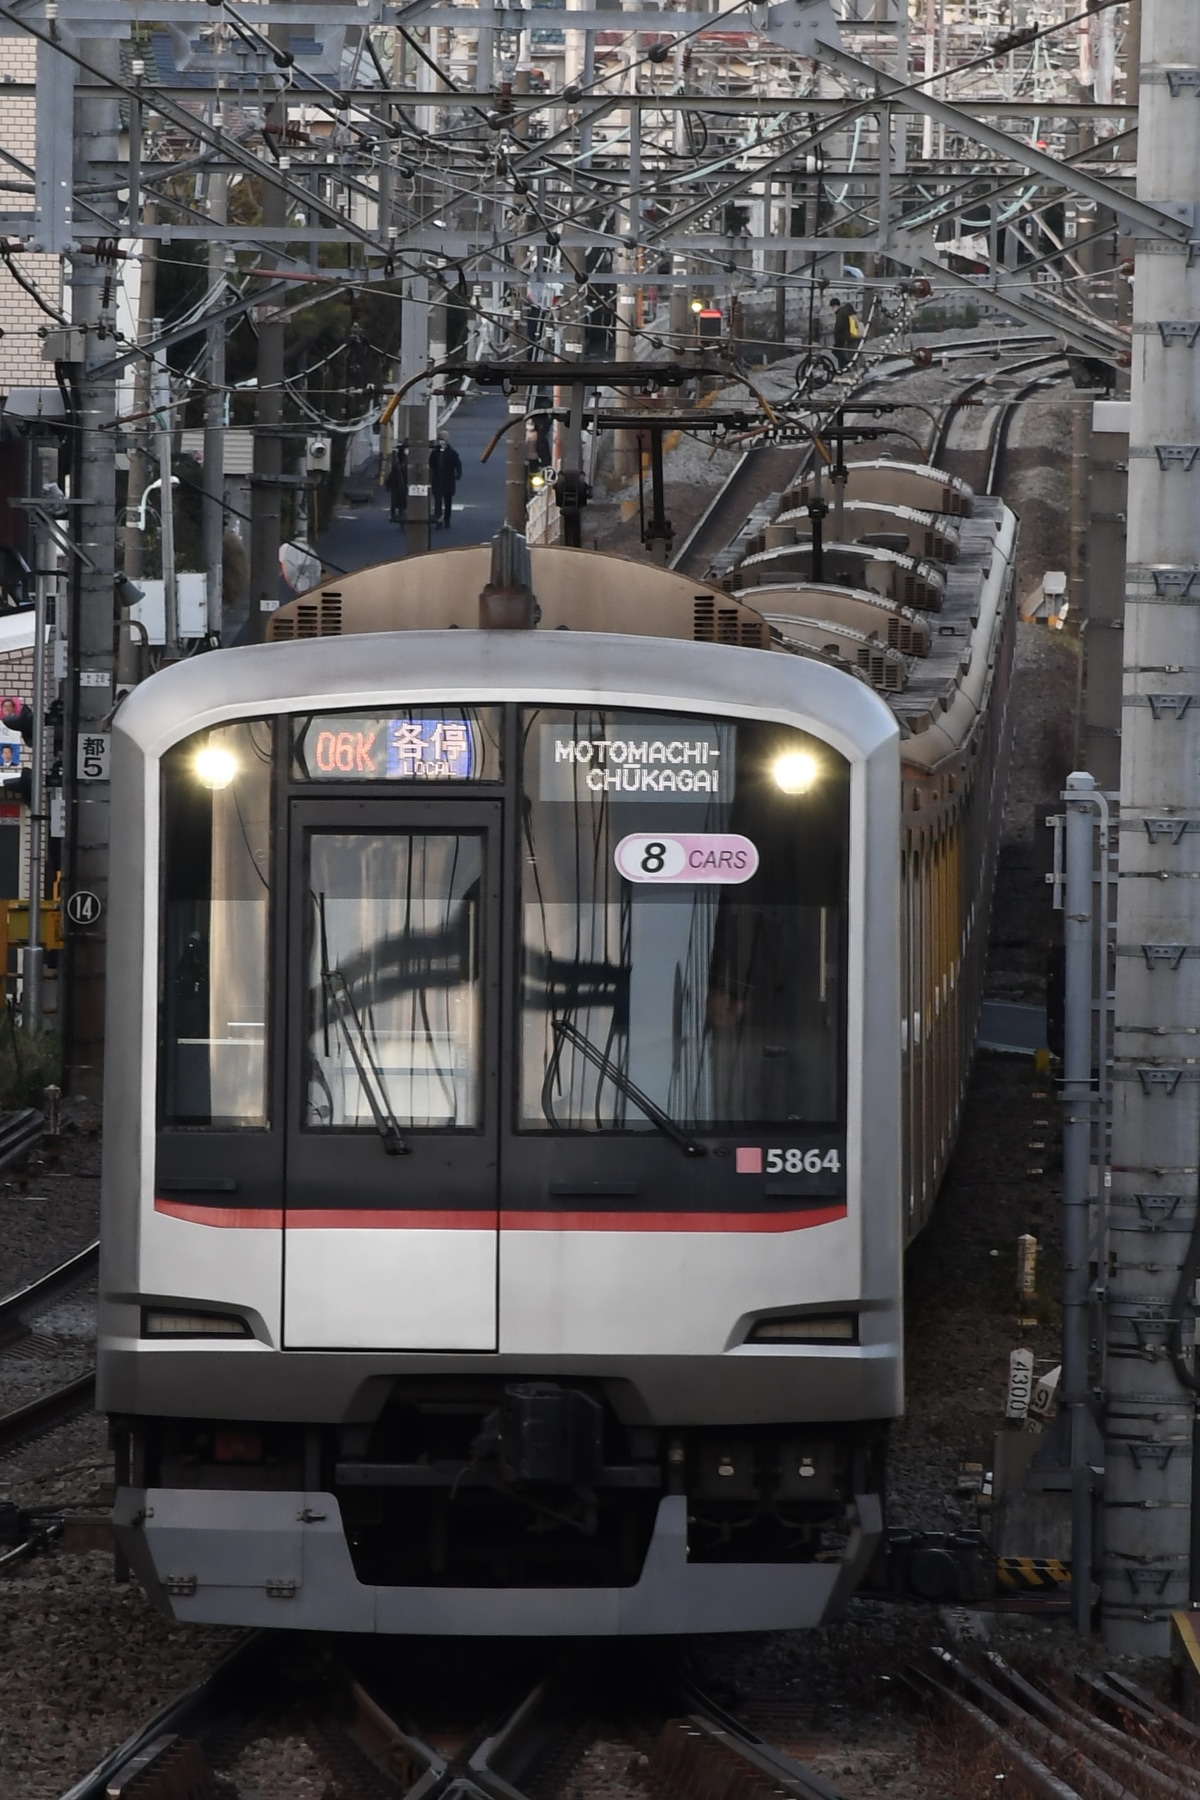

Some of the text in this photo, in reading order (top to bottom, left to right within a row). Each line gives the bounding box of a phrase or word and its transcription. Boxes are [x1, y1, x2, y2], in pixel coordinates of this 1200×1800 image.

[316, 731, 376, 772] 06K
[392, 722, 468, 761] 各停
[554, 740, 721, 764] MOTOMACHI-
[403, 761, 457, 776] LOCAL
[640, 842, 748, 874] 8 CARS
[765, 1148, 841, 1174] 5864
[1009, 1361, 1030, 1411] 4300
